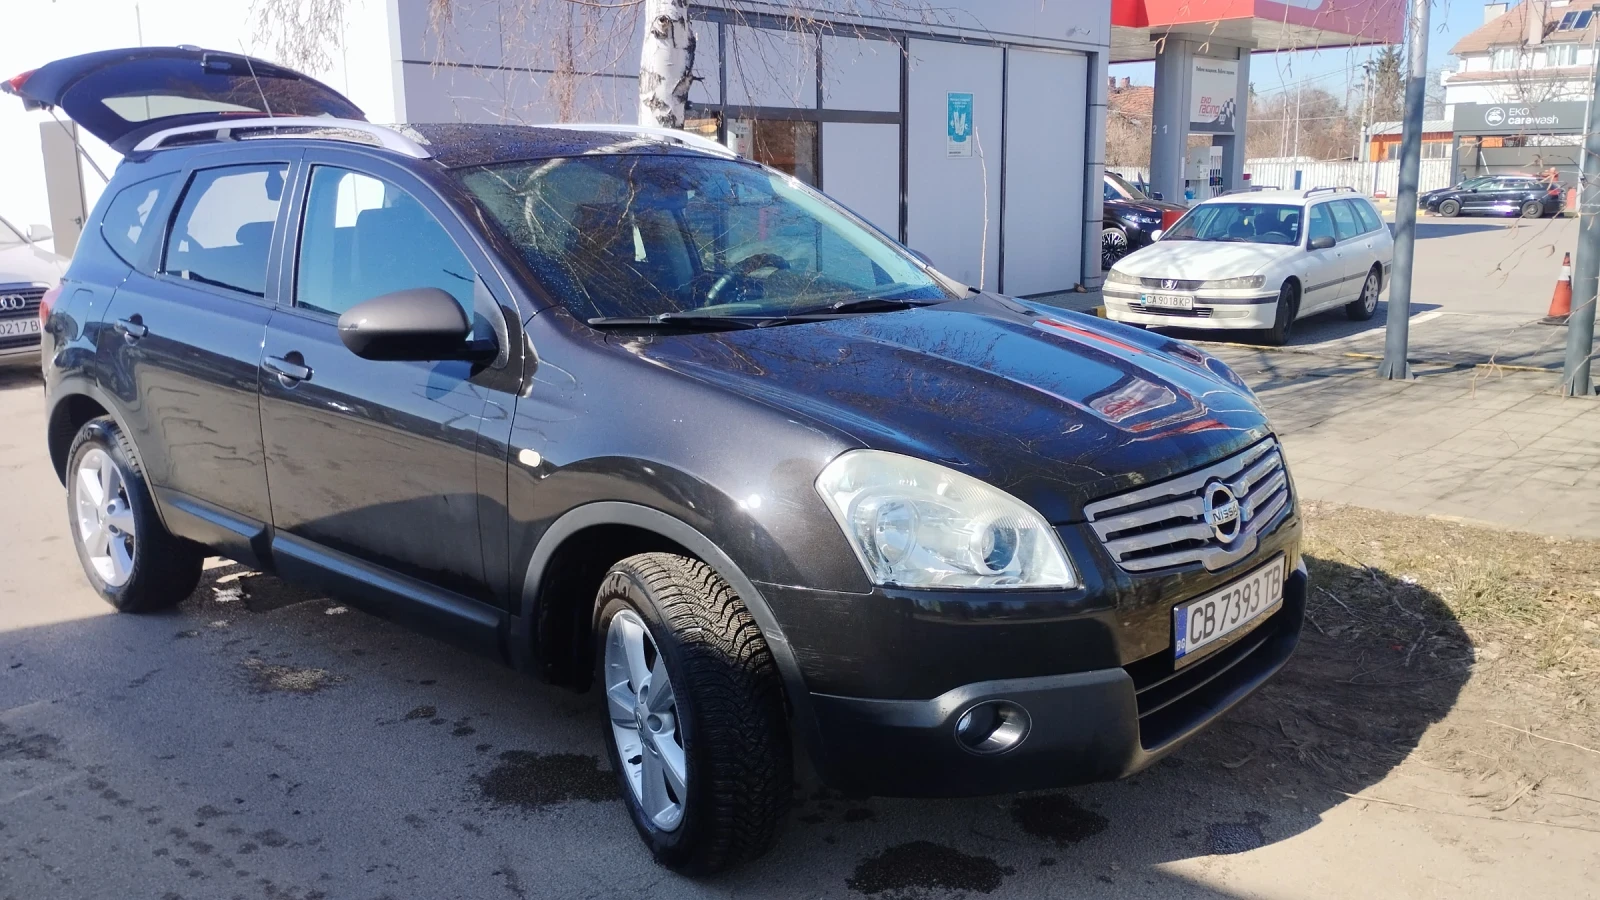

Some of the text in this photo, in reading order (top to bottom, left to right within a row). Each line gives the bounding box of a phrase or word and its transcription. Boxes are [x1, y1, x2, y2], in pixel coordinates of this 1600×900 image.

[1199, 105, 1220, 116] racing
[1509, 108, 1529, 116] EKO
[1152, 124, 1168, 134] 2 1
[1146, 295, 1191, 307] CA 9018 KP
[1190, 564, 1281, 644] CB 7393 TB
[1177, 638, 1185, 651] BG
